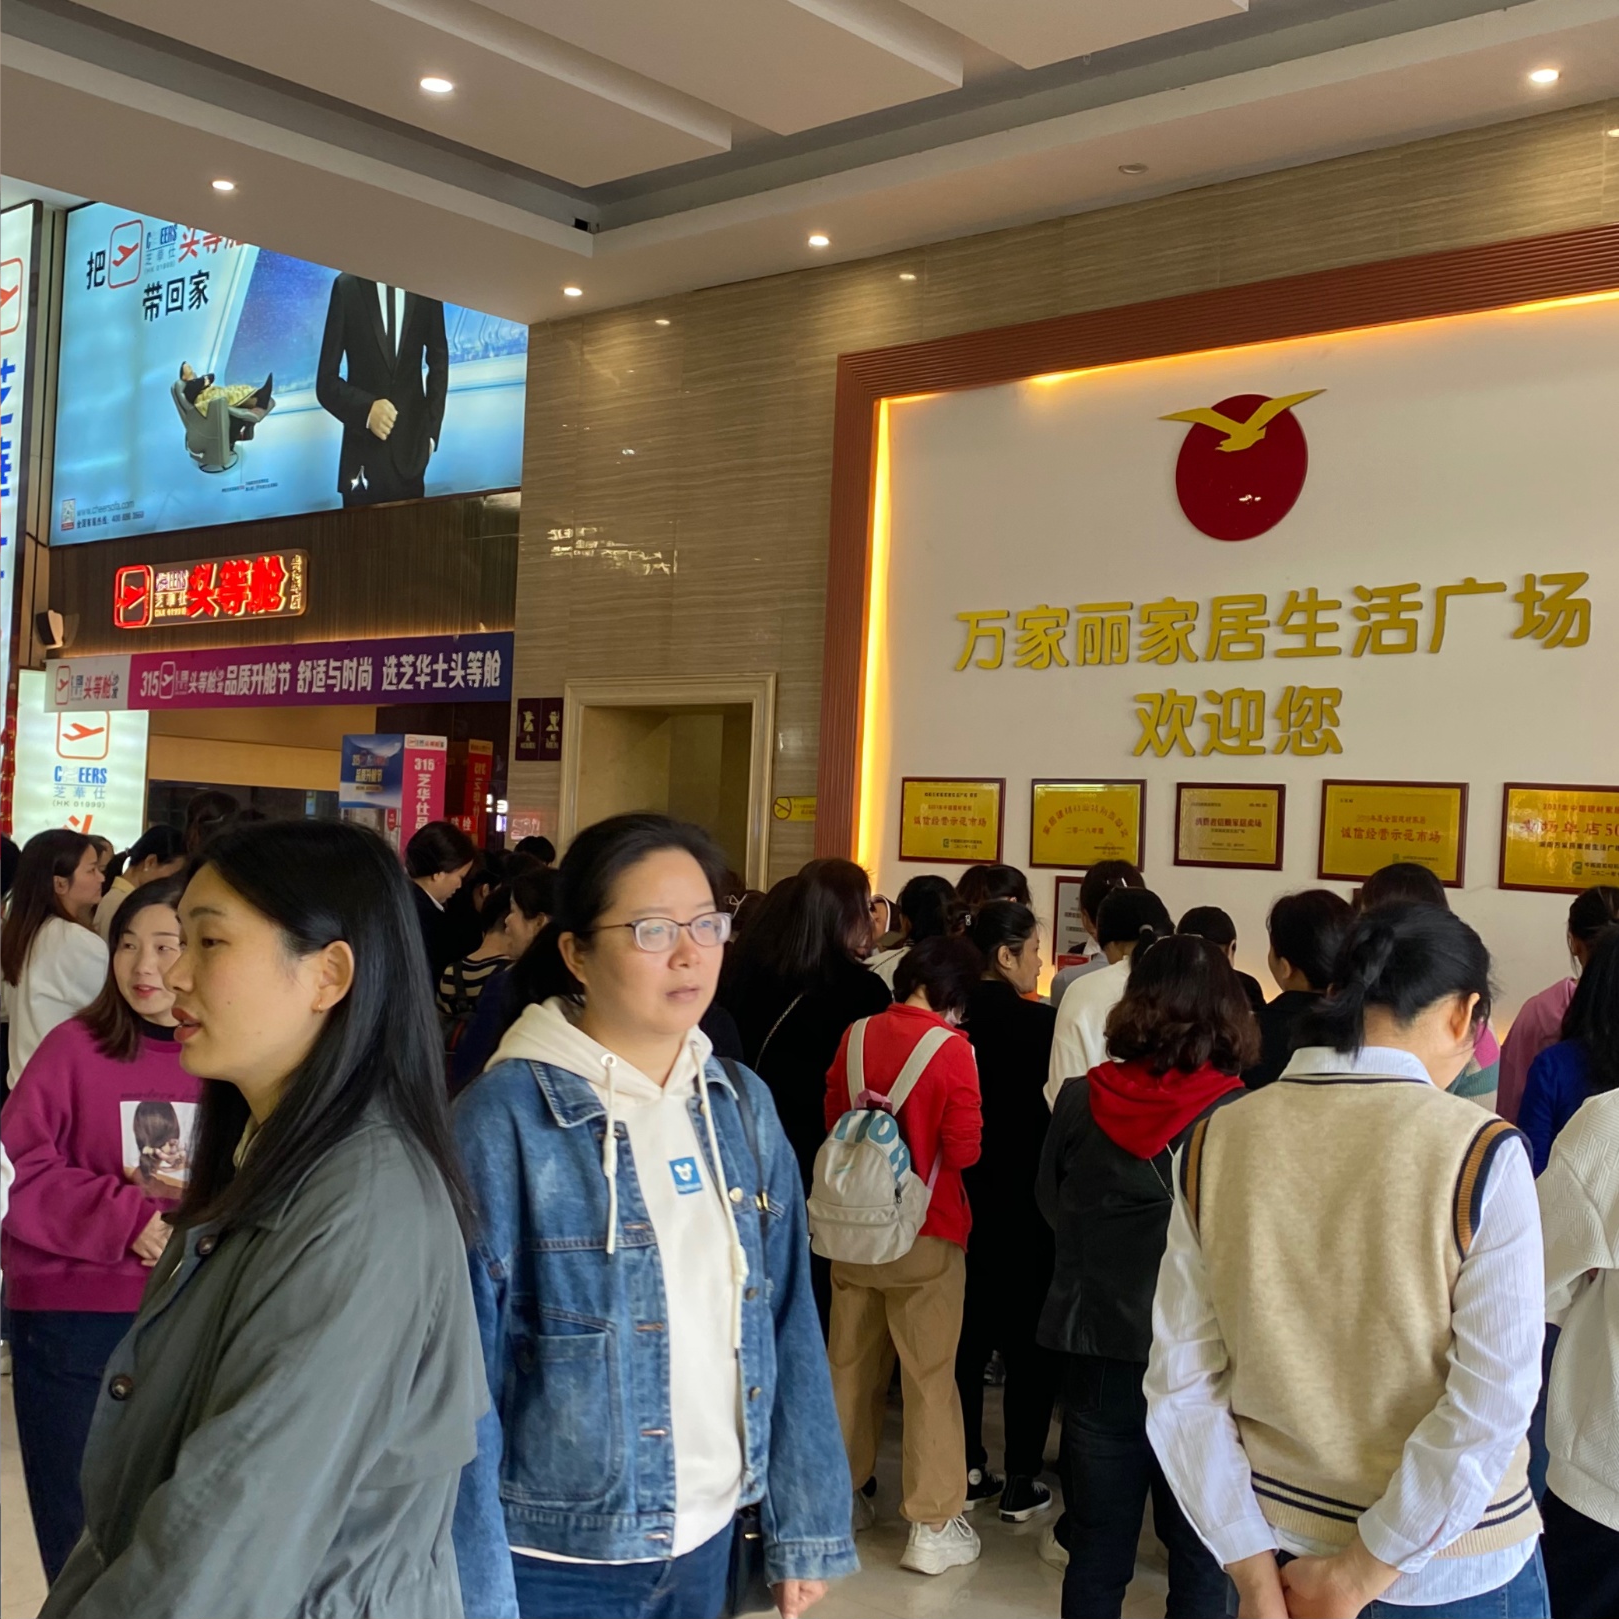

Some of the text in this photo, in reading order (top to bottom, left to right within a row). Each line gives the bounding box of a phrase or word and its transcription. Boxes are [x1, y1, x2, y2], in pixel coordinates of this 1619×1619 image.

[86, 249, 106, 290] 把
[142, 269, 210, 322] 带回家
[954, 571, 1592, 671] 万家丽家居生活广场
[140, 670, 159, 697] 315
[224, 649, 501, 696] 品质升舱节 舒适与时尚 选芝华士头等舱
[1133, 684, 1343, 757] 欢迎您
[414, 757, 436, 771] 315
[1340, 827, 1442, 844] 诚信经营示范市场
